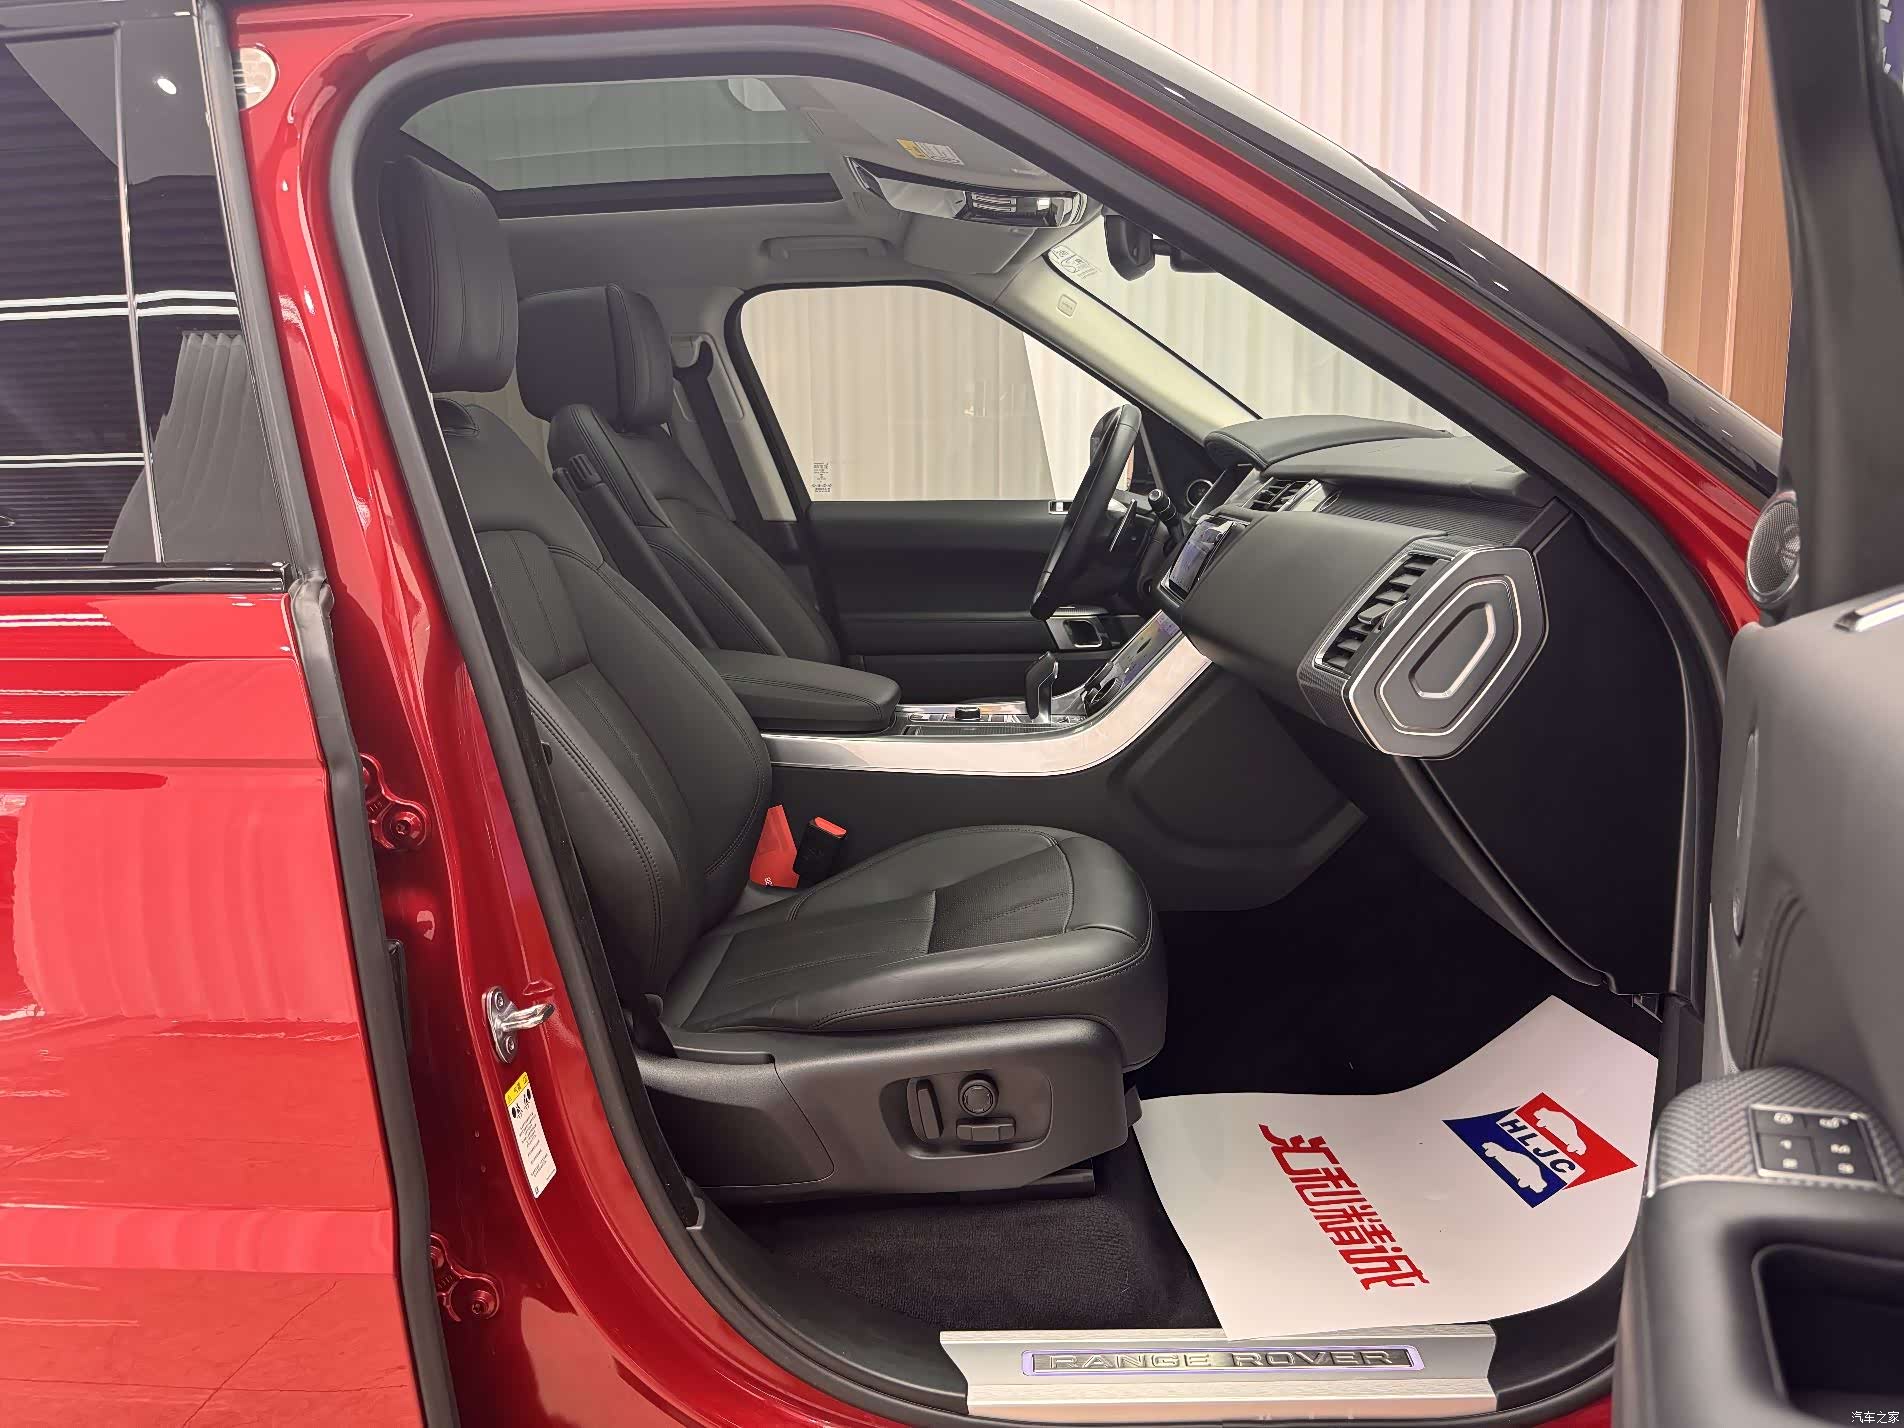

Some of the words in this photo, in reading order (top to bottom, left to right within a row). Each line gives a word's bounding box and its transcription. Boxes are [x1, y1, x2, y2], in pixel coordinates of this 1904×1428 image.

[1500, 1118, 1576, 1173] HLJC
[1258, 1123, 1430, 1290] 汇利精诚
[1050, 1353, 1212, 1369] RANGE
[1231, 1350, 1393, 1367] ROVER
